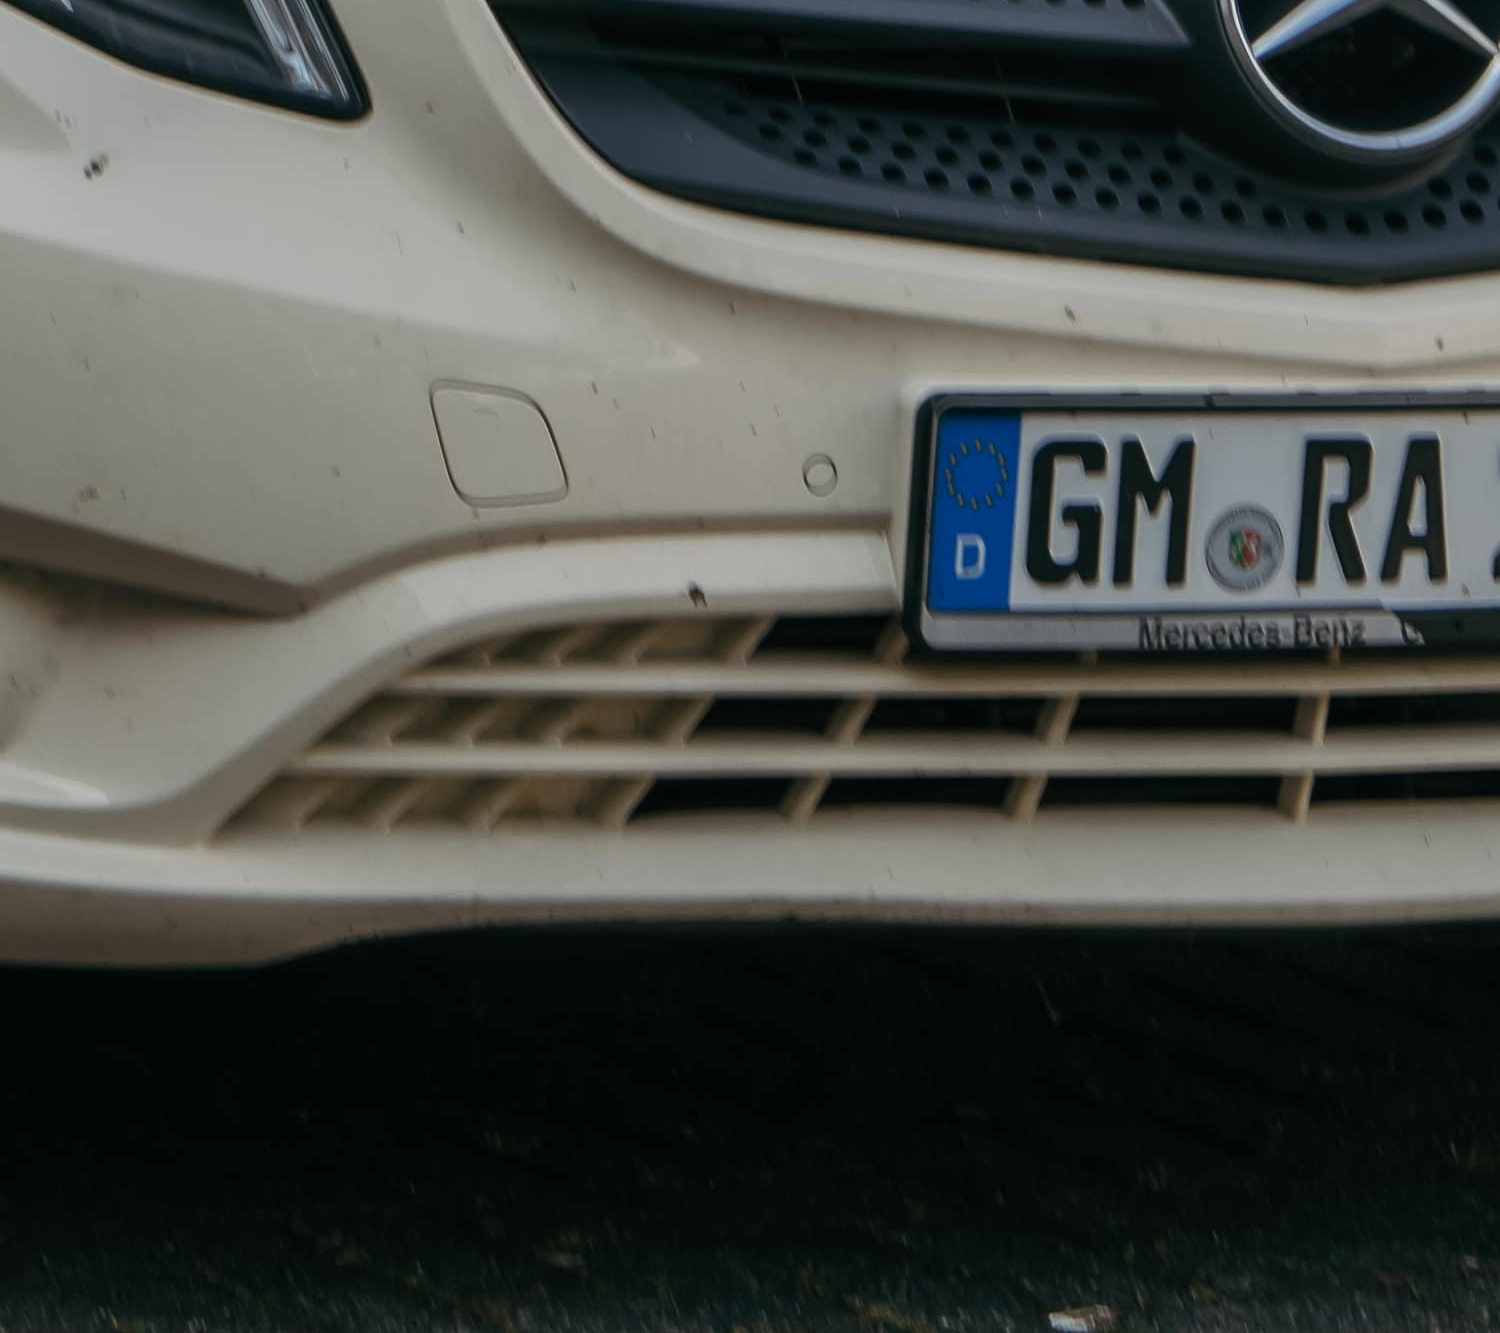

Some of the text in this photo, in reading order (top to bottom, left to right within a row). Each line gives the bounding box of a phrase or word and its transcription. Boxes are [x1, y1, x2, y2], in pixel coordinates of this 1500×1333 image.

[953, 532, 987, 581] D
[1023, 434, 1197, 588] GM
[1293, 436, 1449, 588] RA
